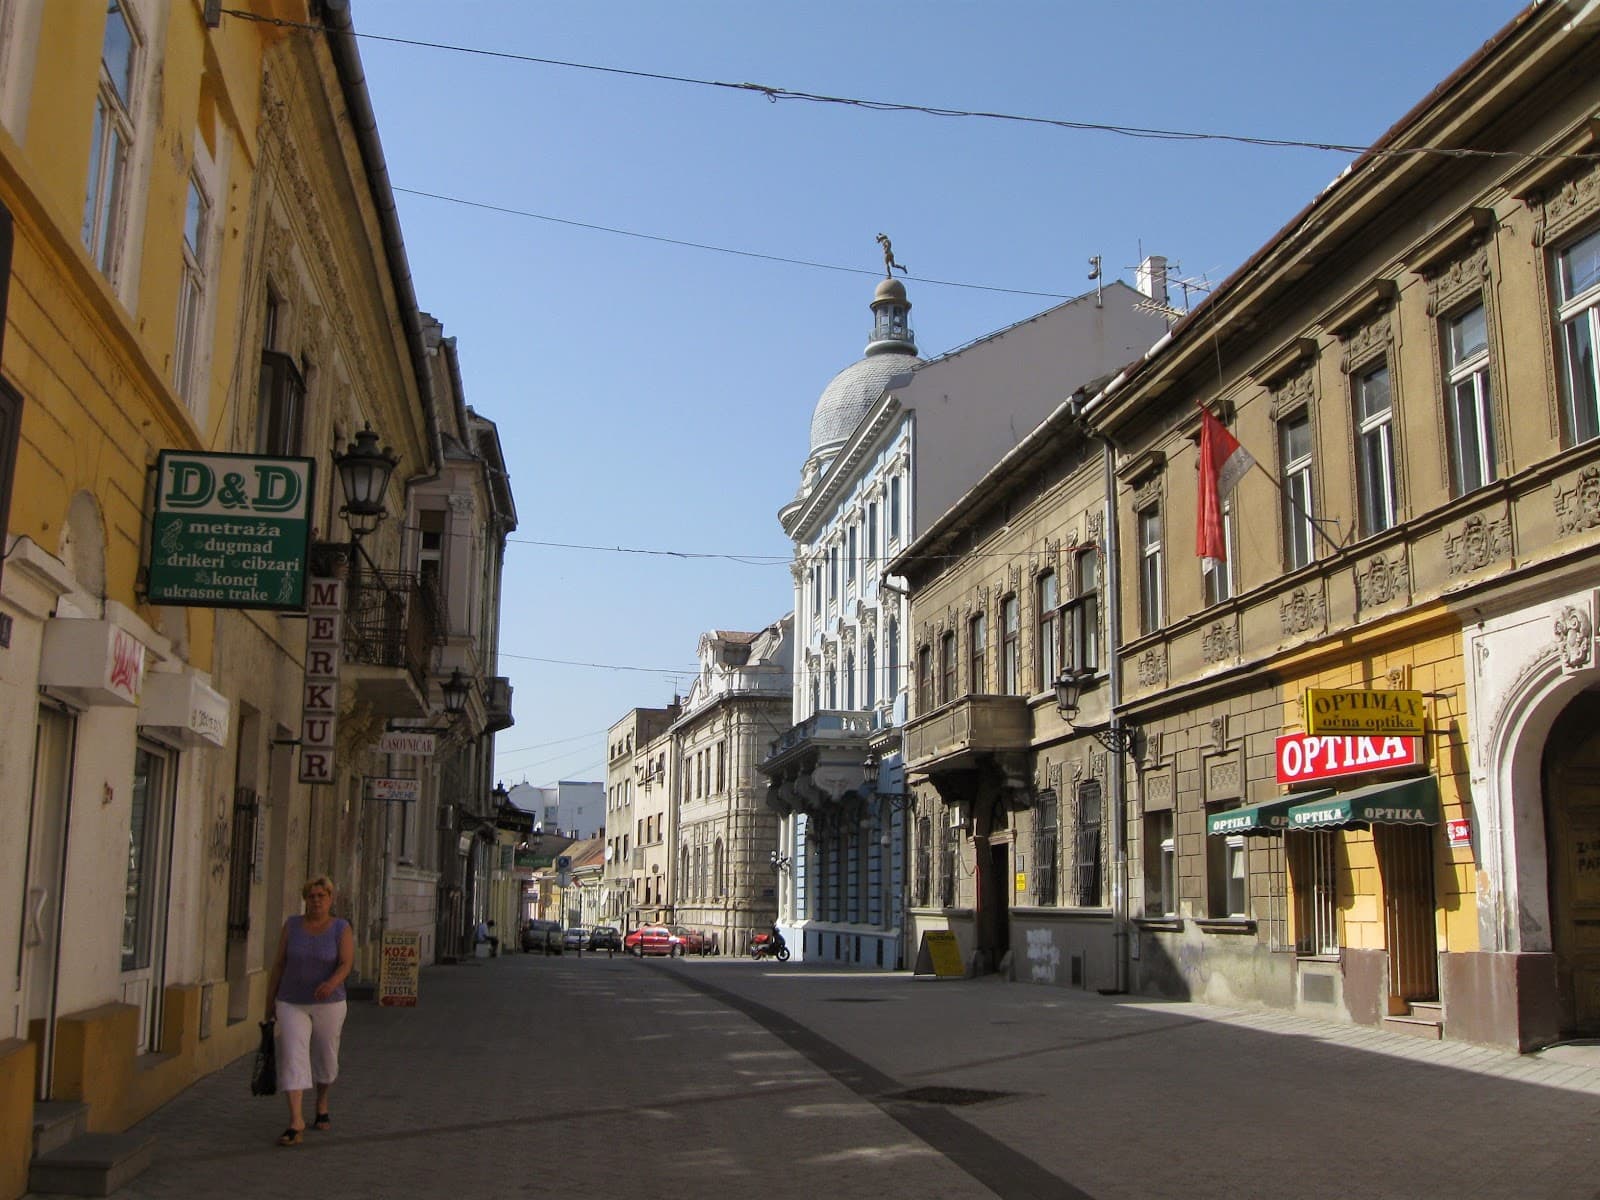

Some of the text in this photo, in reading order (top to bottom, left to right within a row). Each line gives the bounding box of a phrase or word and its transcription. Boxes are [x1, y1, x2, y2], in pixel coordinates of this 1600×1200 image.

[165, 460, 302, 513] D&D
[189, 522, 281, 537] metraža
[204, 538, 273, 555] dugmad
[167, 552, 300, 572] drikeri cibzari
[212, 571, 259, 587] konci
[163, 584, 268, 601] ukrasne trake
[303, 583, 338, 778] MERKUR
[1315, 692, 1420, 716] OPTIMAX
[1323, 714, 1414, 732] očna optika
[1282, 736, 1407, 777] OPTIKA
[1294, 808, 1344, 824] OPTIKA
[1364, 807, 1425, 820] OPTIKA
[1213, 815, 1251, 830] OPTIKA
[384, 945, 416, 958] KOŽA
